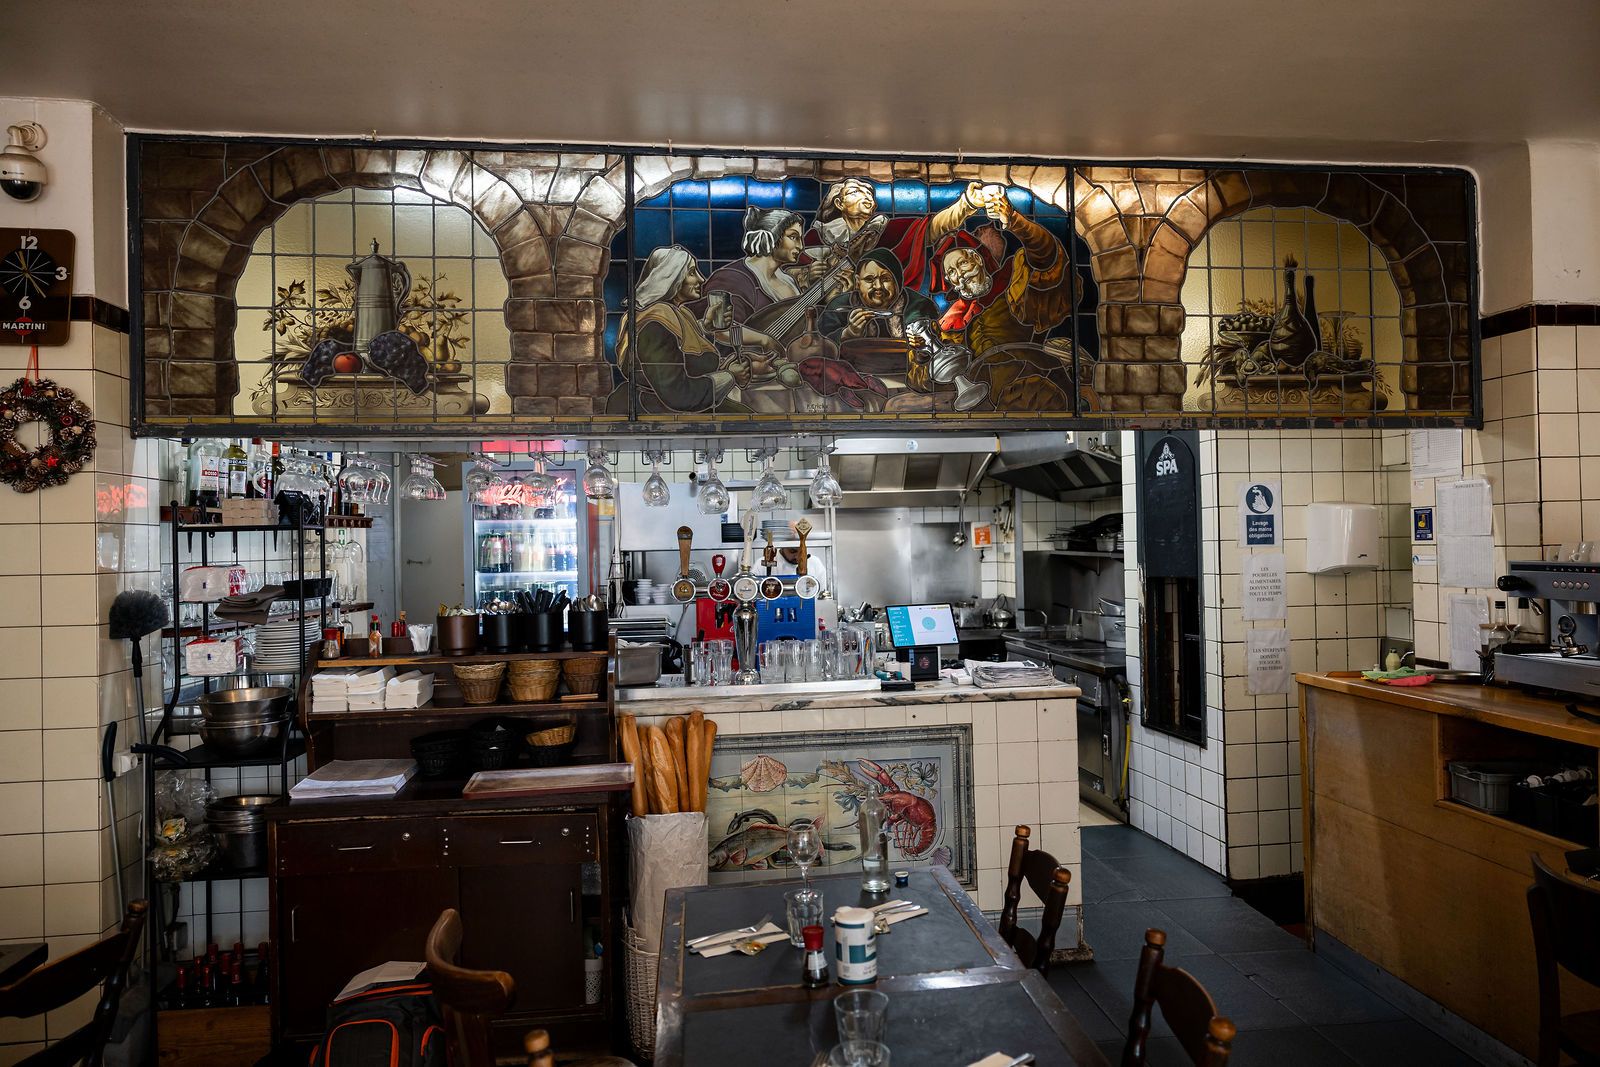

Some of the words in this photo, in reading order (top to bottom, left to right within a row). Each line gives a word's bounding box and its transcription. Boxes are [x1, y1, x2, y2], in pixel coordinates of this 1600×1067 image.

[21, 235, 38, 250] 12
[55, 266, 67, 281] 3
[18, 296, 32, 310] 6
[1156, 458, 1179, 477] SPA
